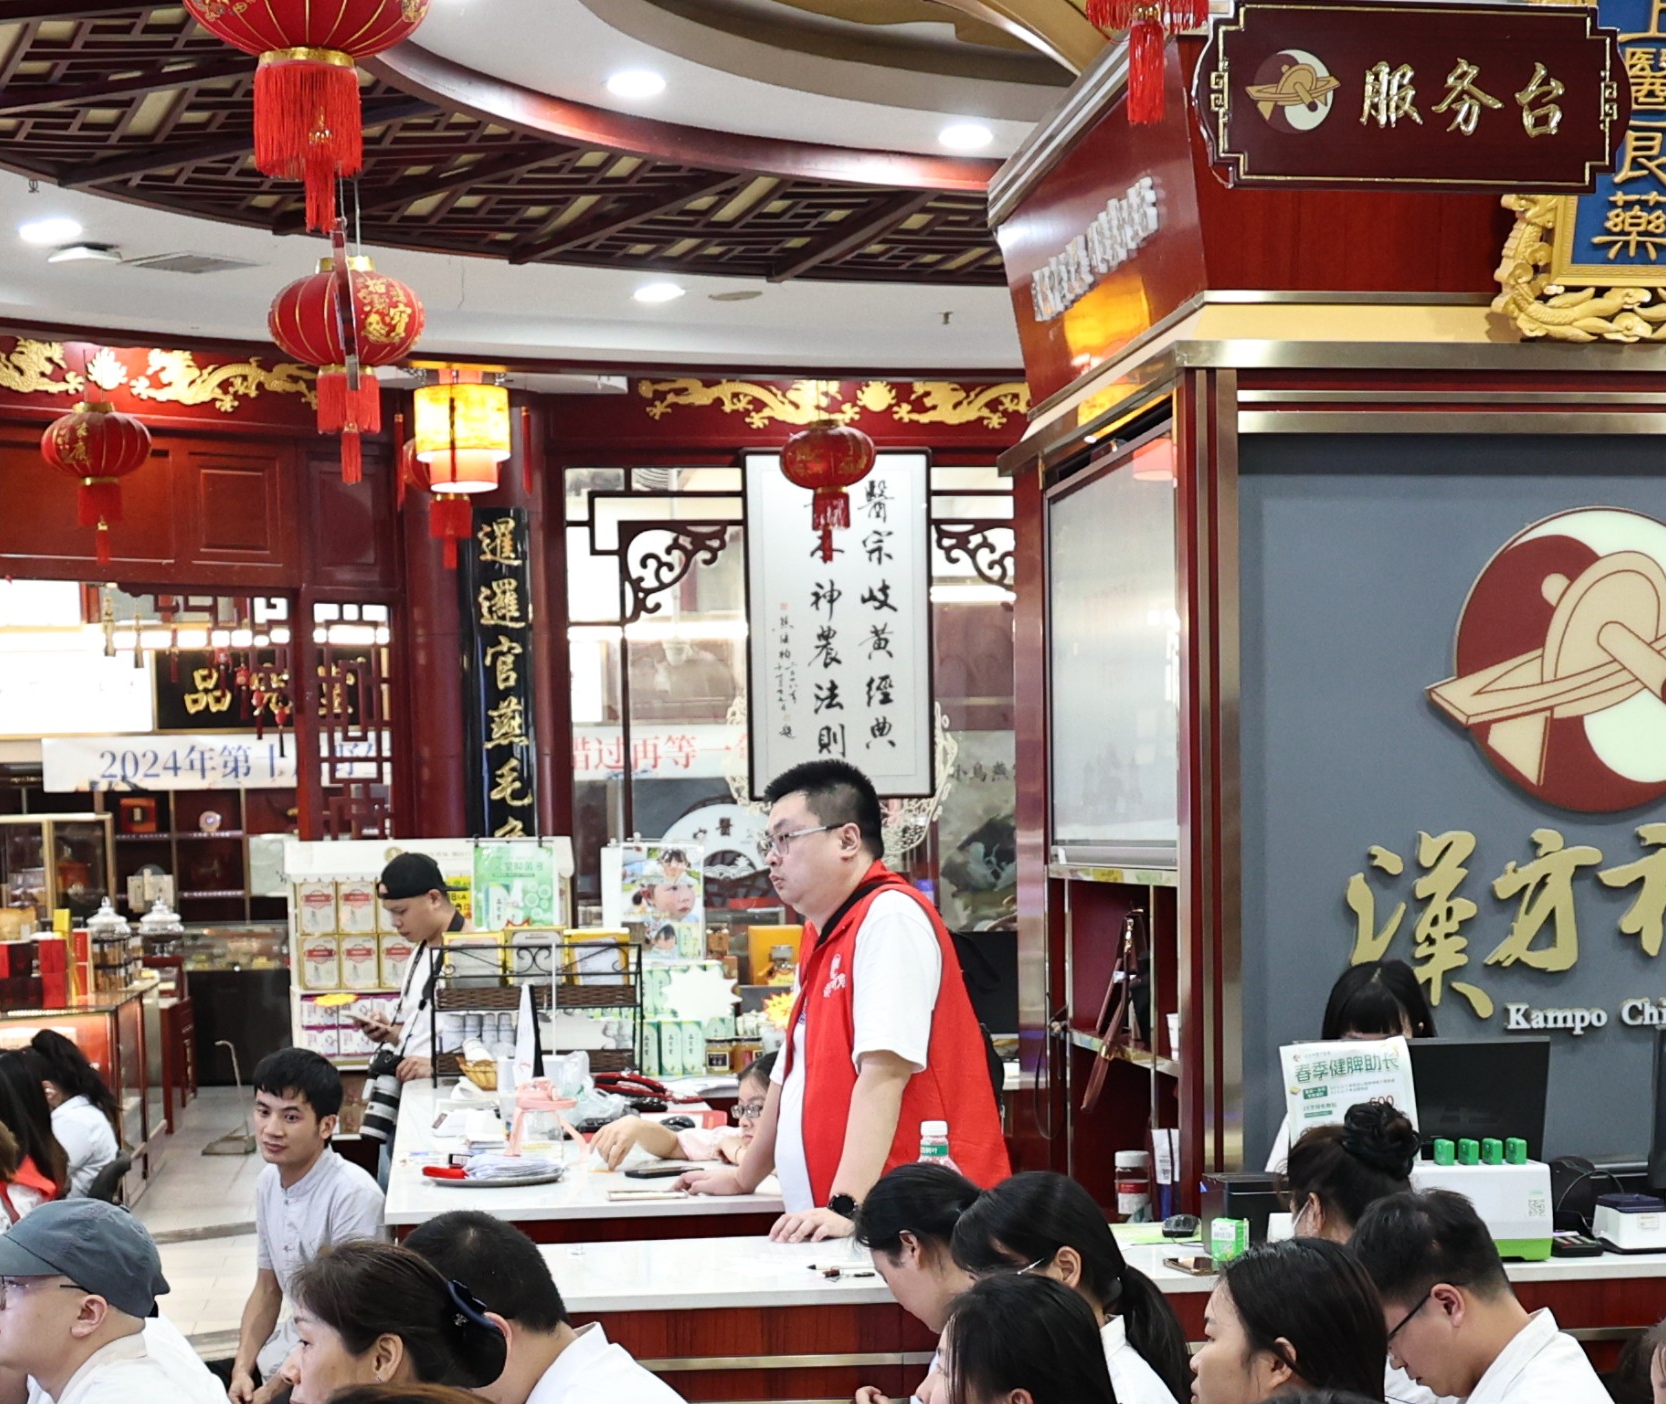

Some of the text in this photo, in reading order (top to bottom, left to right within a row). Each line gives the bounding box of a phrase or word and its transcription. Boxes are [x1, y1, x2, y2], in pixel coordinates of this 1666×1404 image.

[1360, 57, 1567, 137] 服务台
[1506, 1003, 1608, 1035] Kampo
